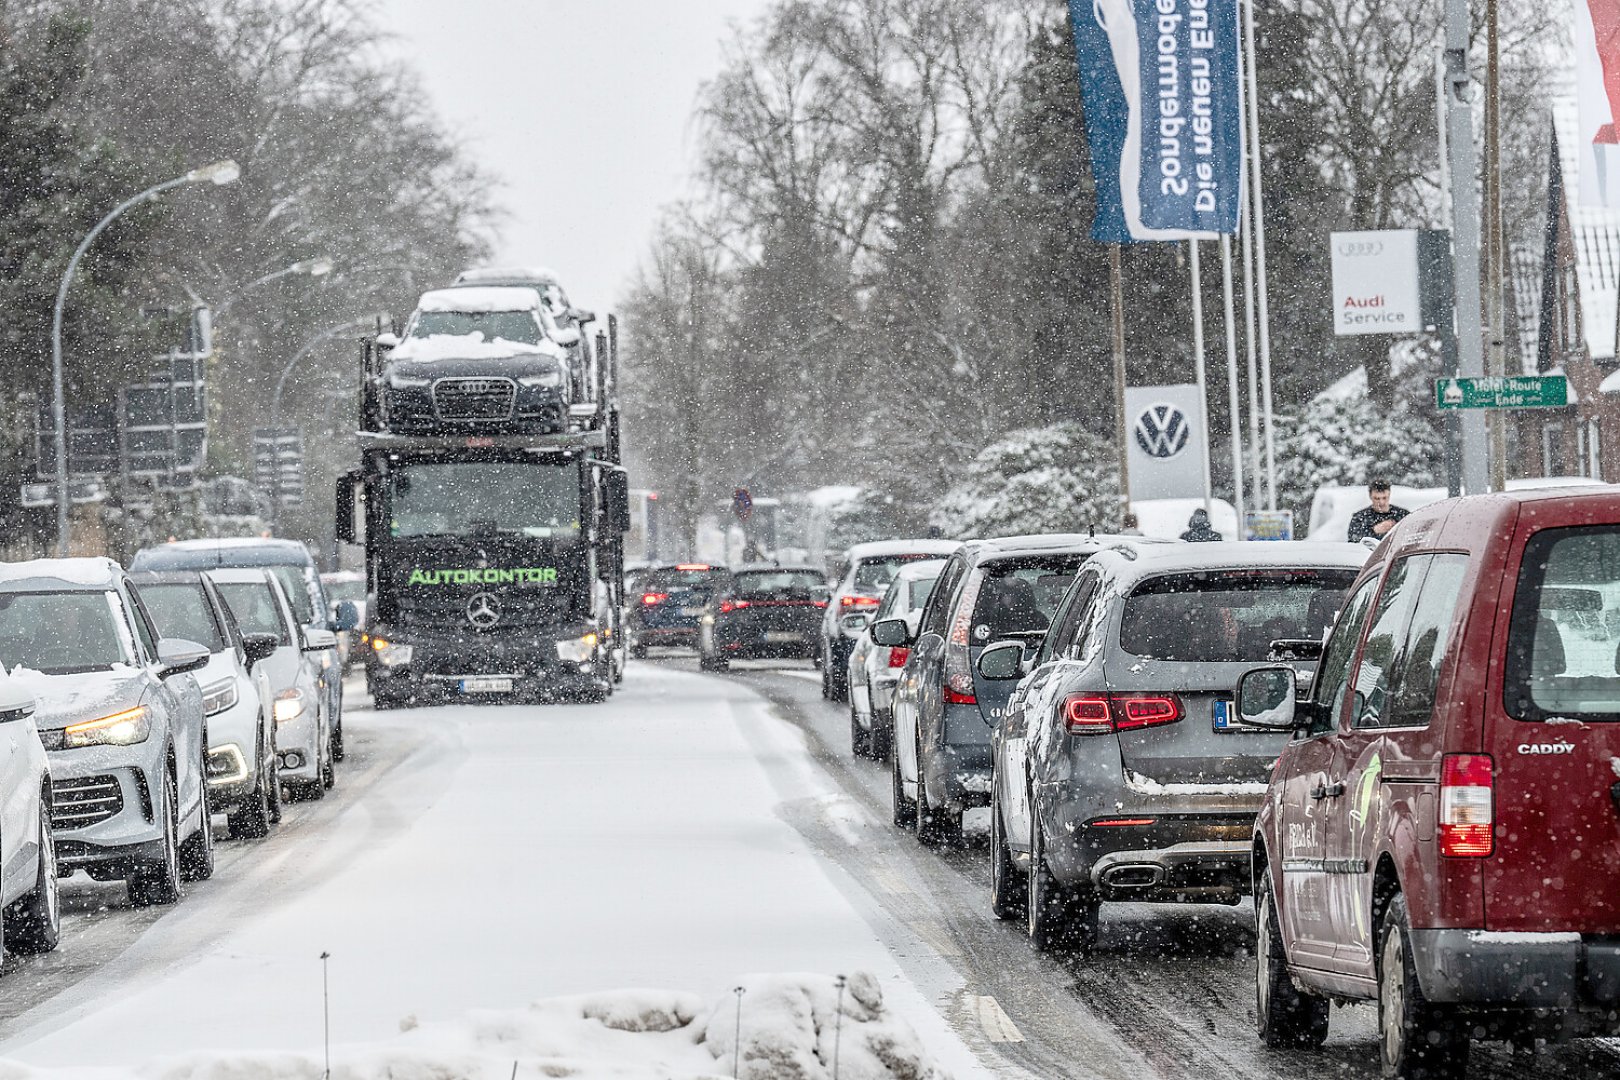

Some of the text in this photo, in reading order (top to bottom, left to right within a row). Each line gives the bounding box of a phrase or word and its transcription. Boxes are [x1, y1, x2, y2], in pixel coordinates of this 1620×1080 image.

[1344, 294, 1385, 308] Audi
[1343, 310, 1405, 325] Service
[1495, 393, 1524, 406] Ende
[408, 568, 557, 586] AUTOKONTOR
[1517, 743, 1576, 755] CADDY
